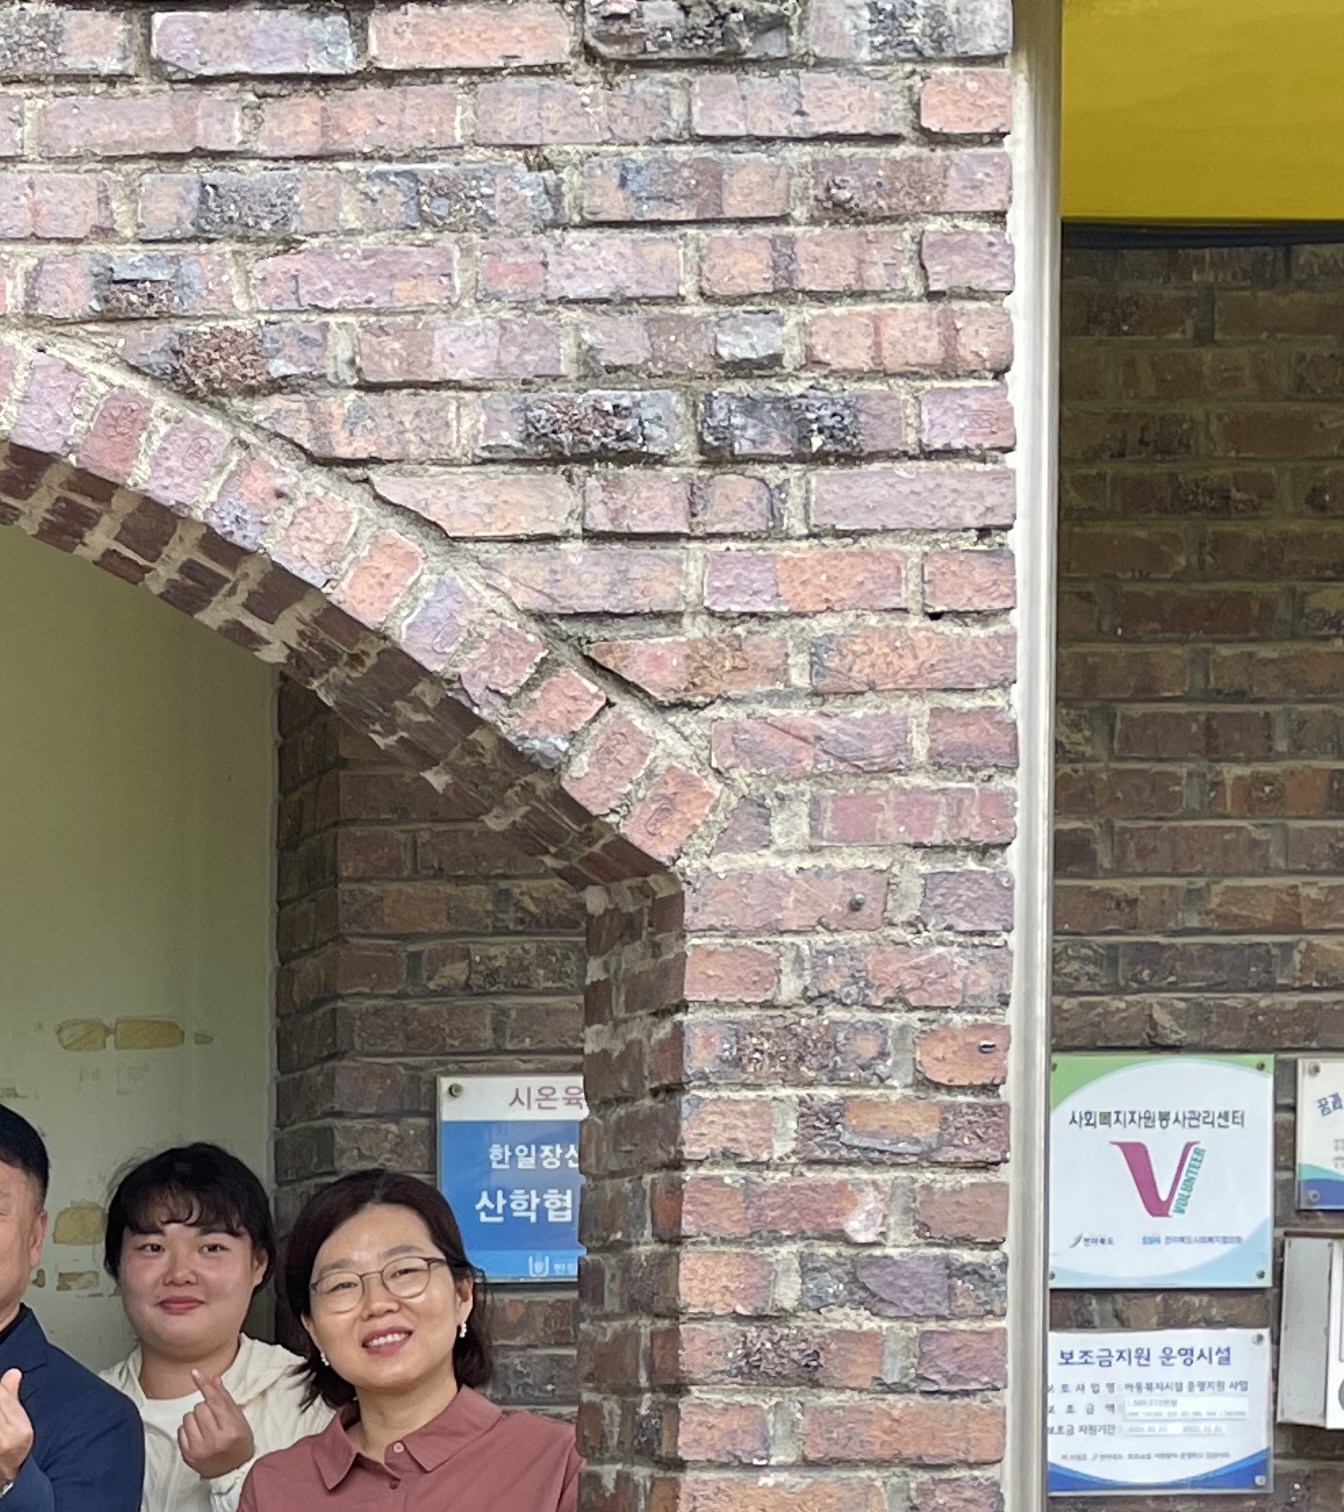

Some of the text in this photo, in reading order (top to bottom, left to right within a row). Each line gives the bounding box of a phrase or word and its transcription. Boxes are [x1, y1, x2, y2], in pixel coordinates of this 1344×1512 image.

[1069, 1109, 1246, 1129] 사회복지자원봉사관리센터
[1172, 1147, 1206, 1215] VOLUNTEER
[475, 1189, 572, 1223] 산학협
[1058, 1345, 1232, 1367] 보조금지원 운영시설
